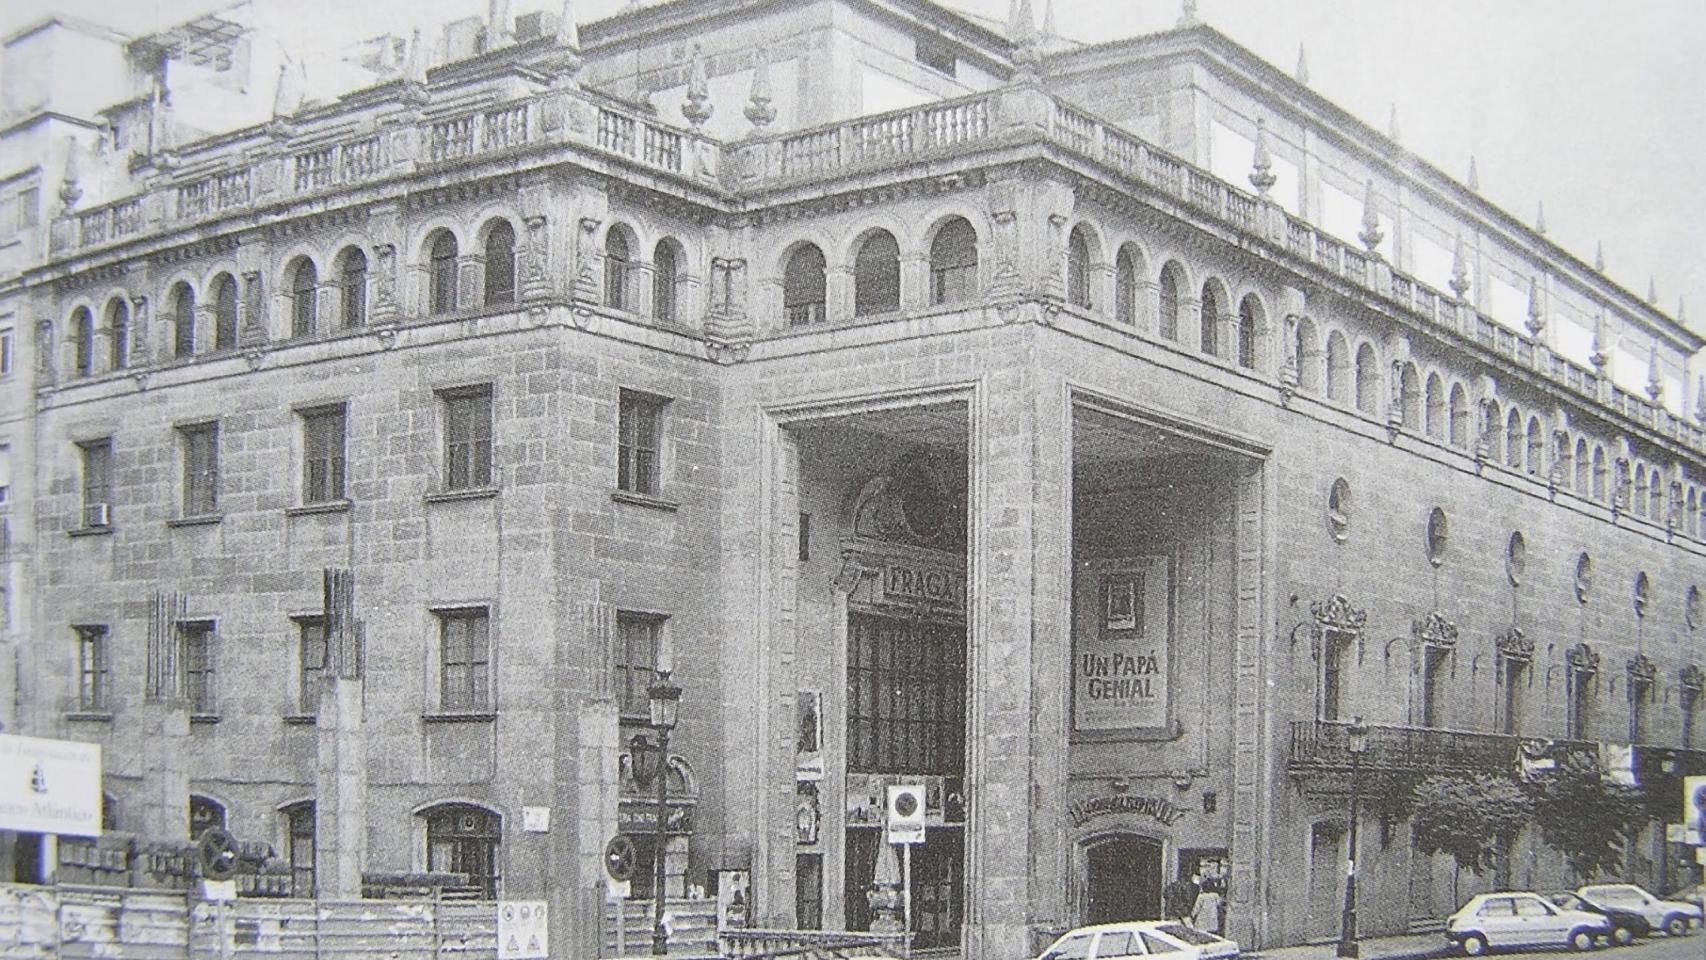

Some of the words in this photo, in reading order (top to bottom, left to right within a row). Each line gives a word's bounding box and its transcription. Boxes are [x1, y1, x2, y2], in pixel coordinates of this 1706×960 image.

[1083, 653, 1109, 677] UN
[1113, 650, 1160, 676] PAPÁ
[1088, 677, 1155, 700] GENIAL
